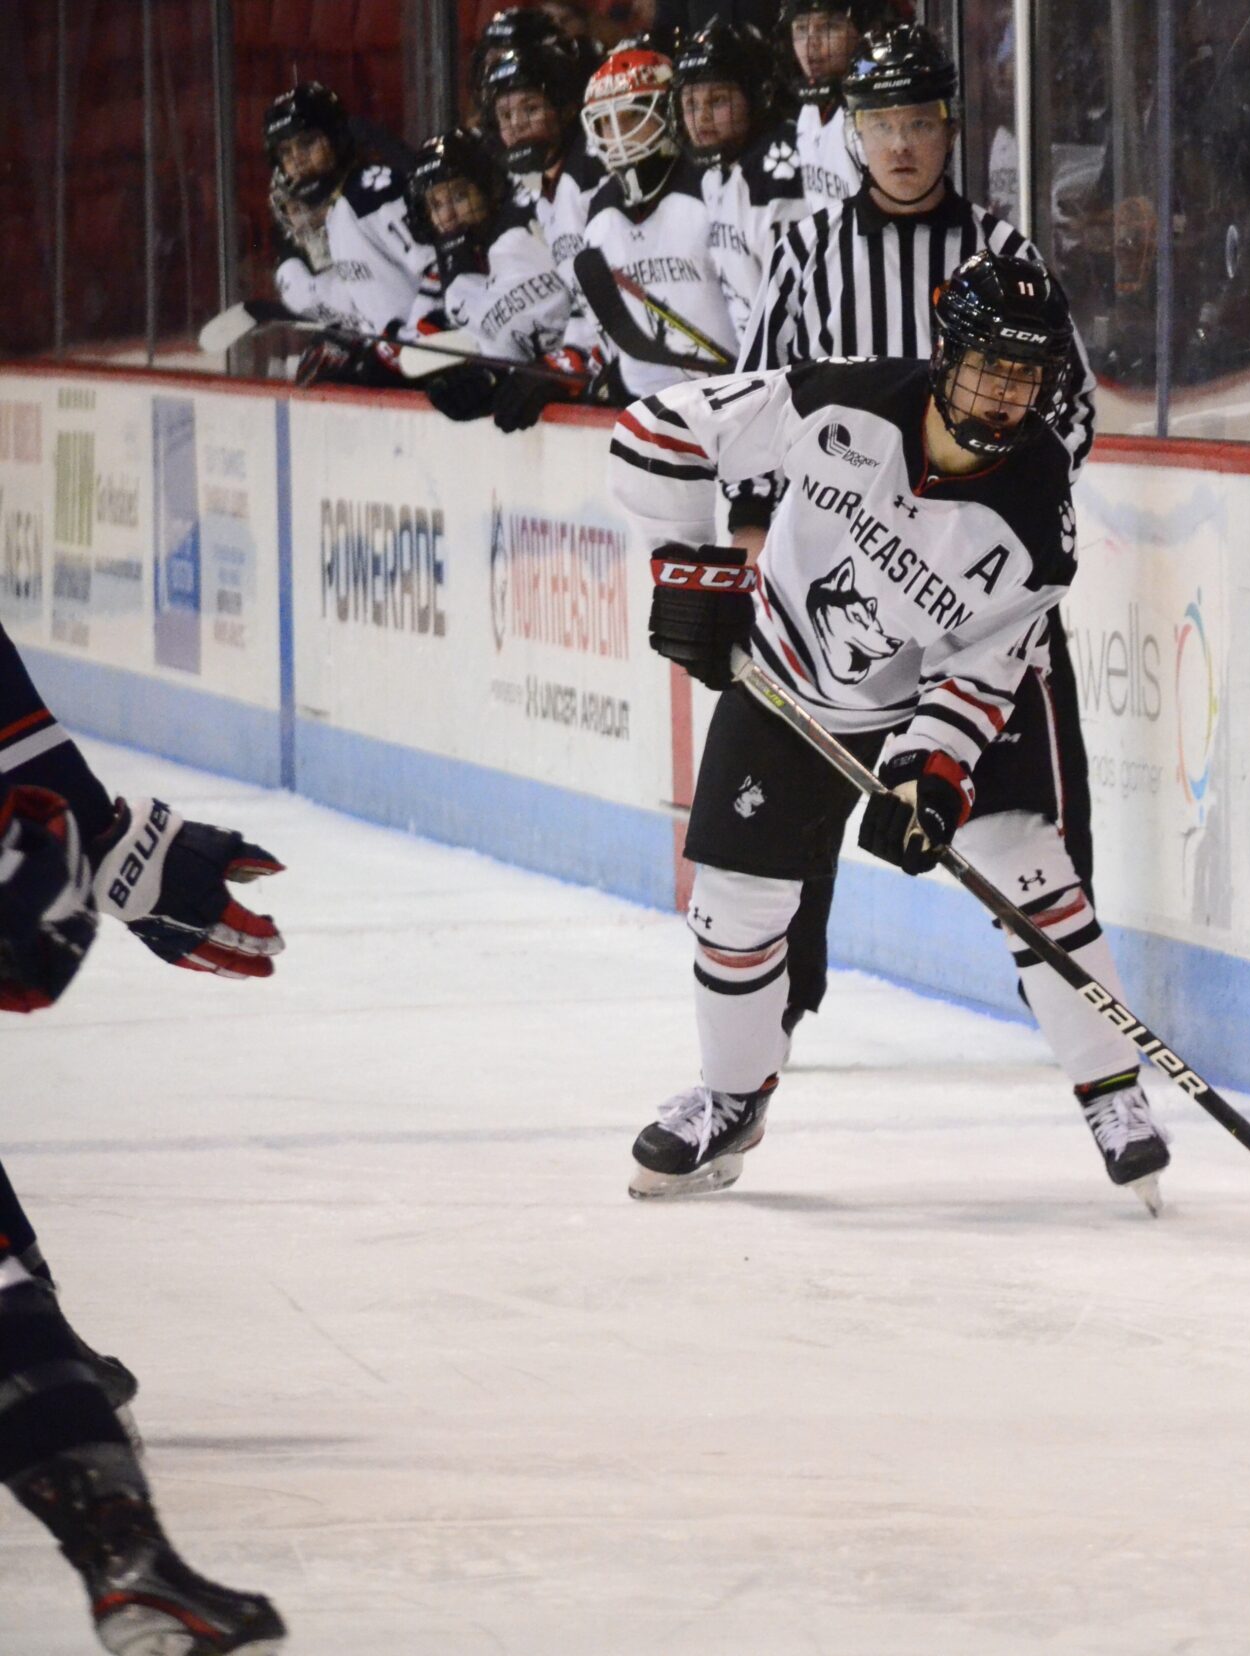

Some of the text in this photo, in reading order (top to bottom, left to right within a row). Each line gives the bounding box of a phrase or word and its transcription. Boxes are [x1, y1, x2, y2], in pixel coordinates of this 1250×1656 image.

[872, 78, 912, 90] BAUER
[1017, 281, 1035, 296] 11
[1000, 327, 1048, 344] CCM
[321, 498, 446, 637] POWERADE
[510, 513, 631, 662] NORTHEASTERN
[964, 543, 1012, 596] A
[541, 680, 579, 727] UNDER
[580, 690, 631, 741] ARMOUR
[1075, 980, 1209, 1101] BAUER
